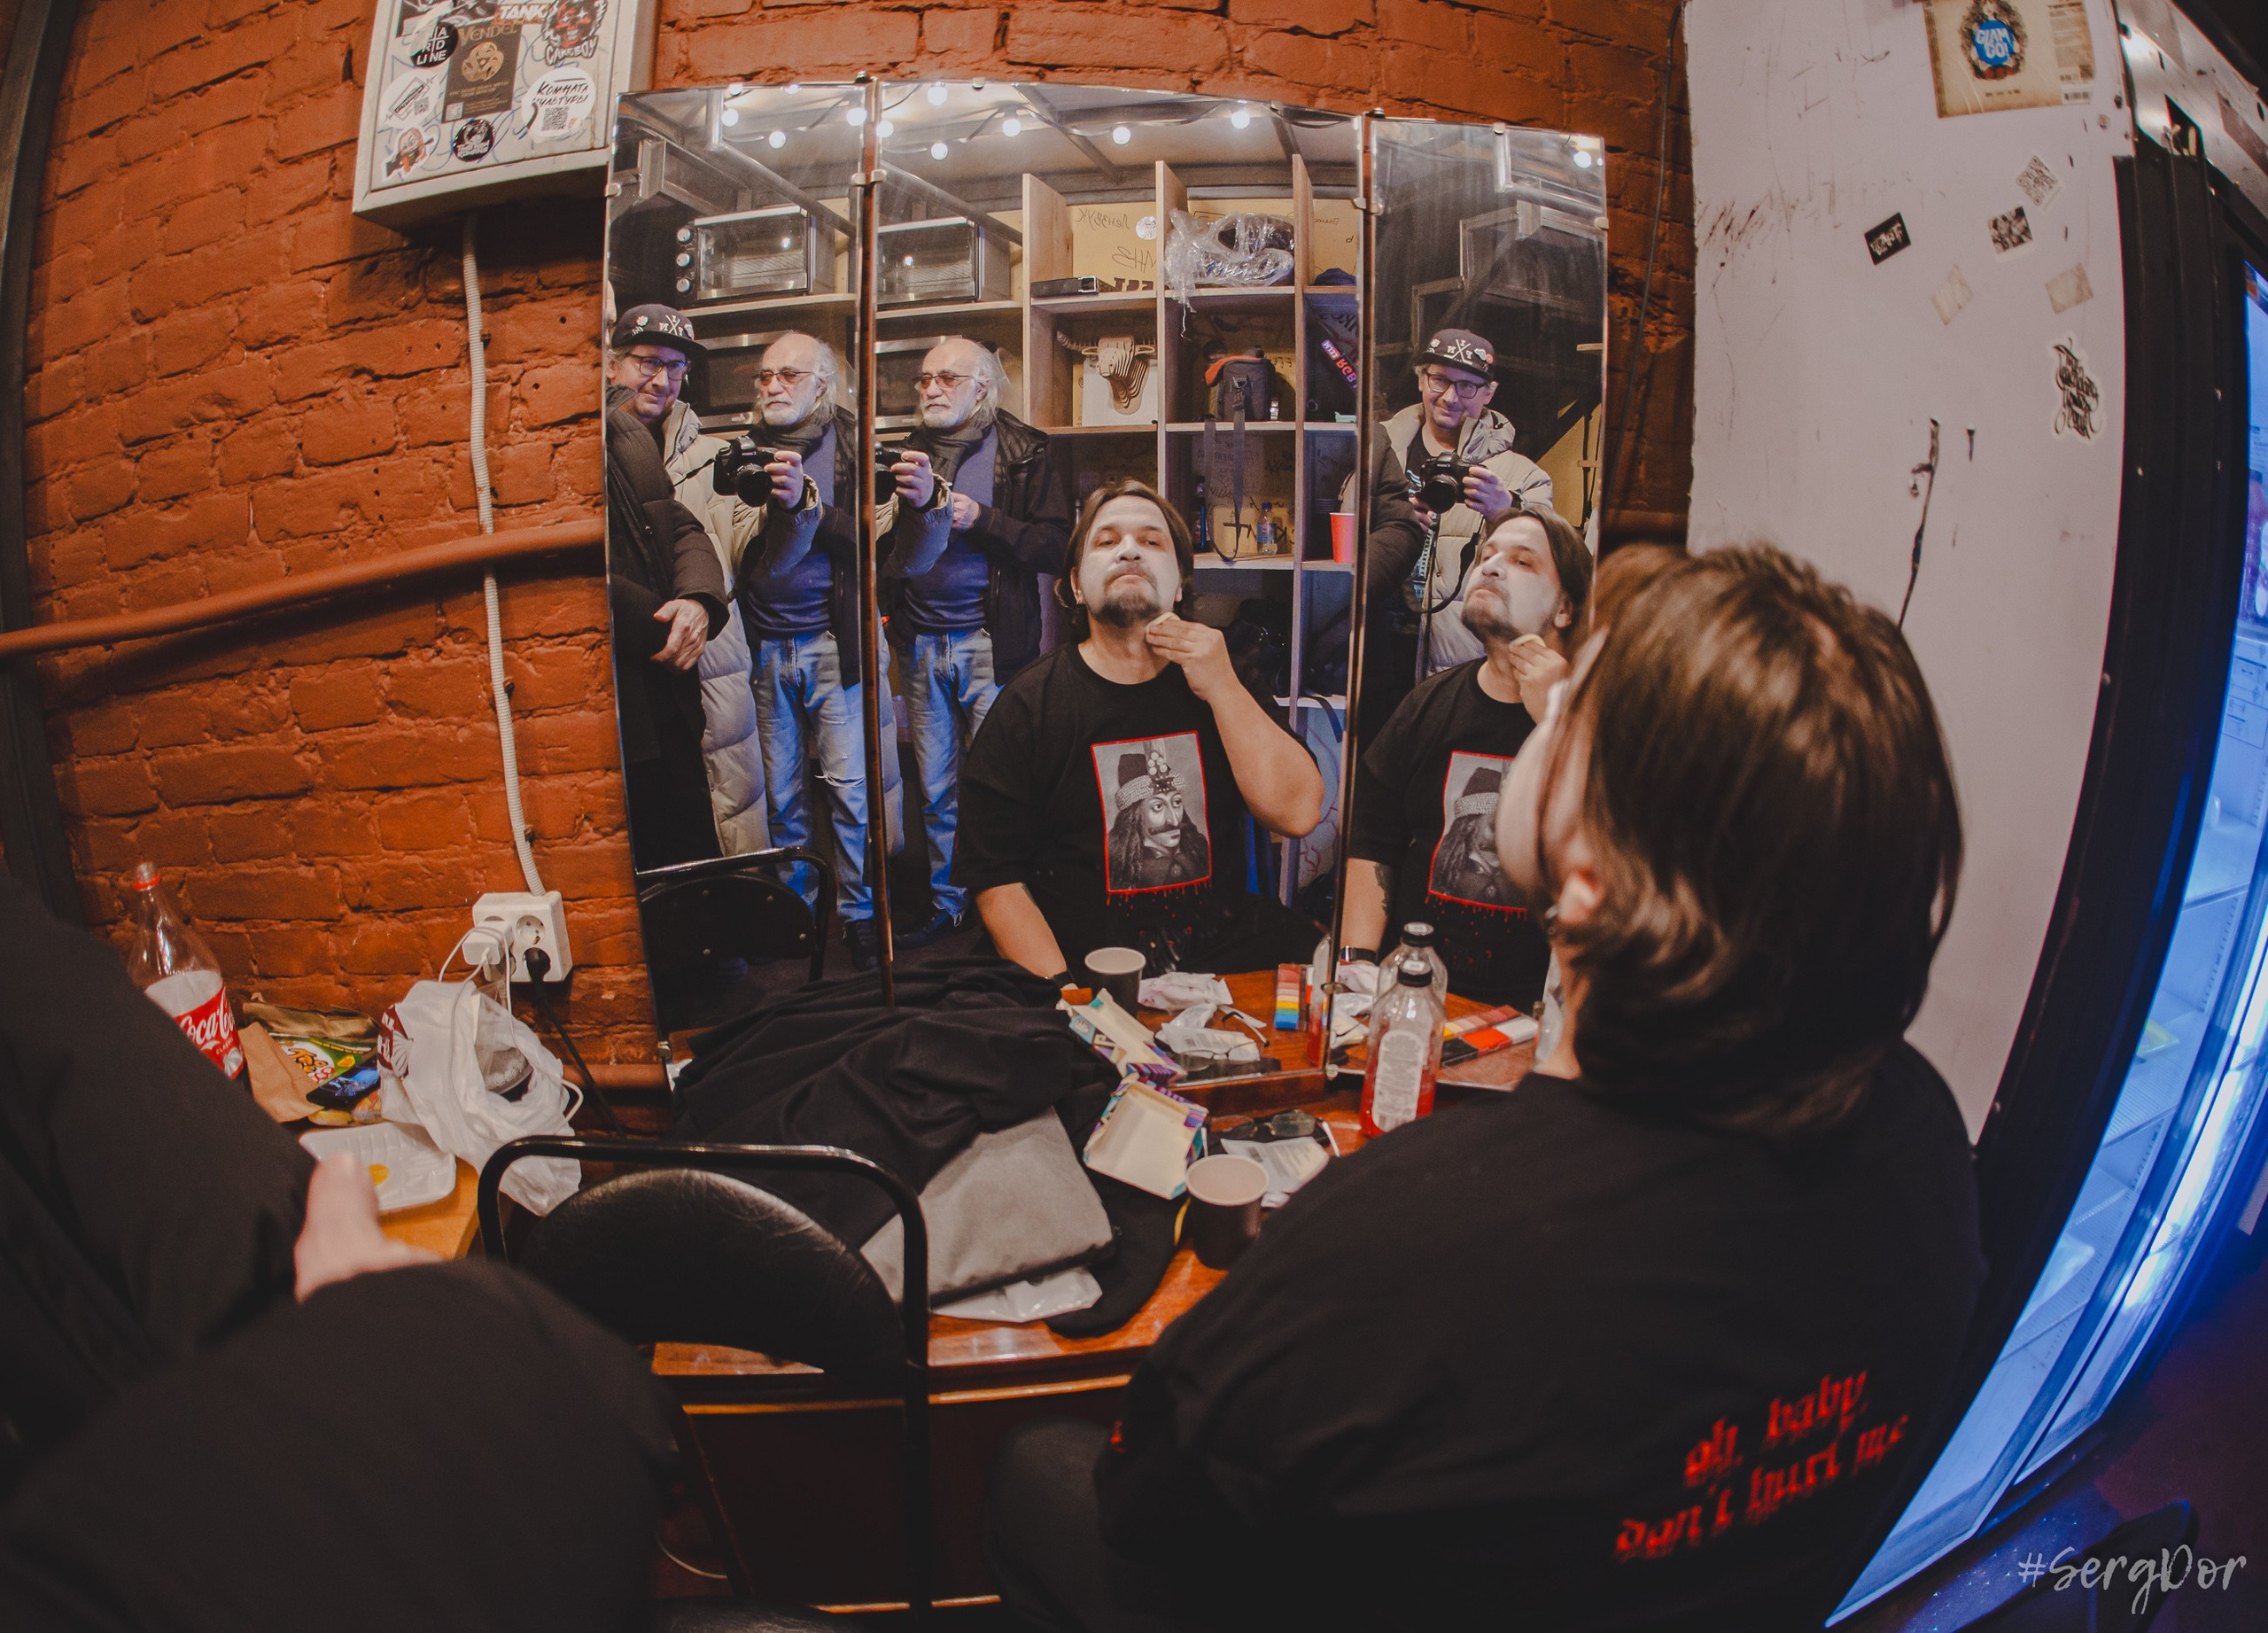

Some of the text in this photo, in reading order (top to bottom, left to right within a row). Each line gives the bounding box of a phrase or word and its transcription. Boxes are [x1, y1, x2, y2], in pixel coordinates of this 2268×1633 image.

[1975, 27, 2011, 45] GLAM
[1984, 42, 2010, 59] GO!
[532, 94, 589, 107] УЛЬТУРЫ
